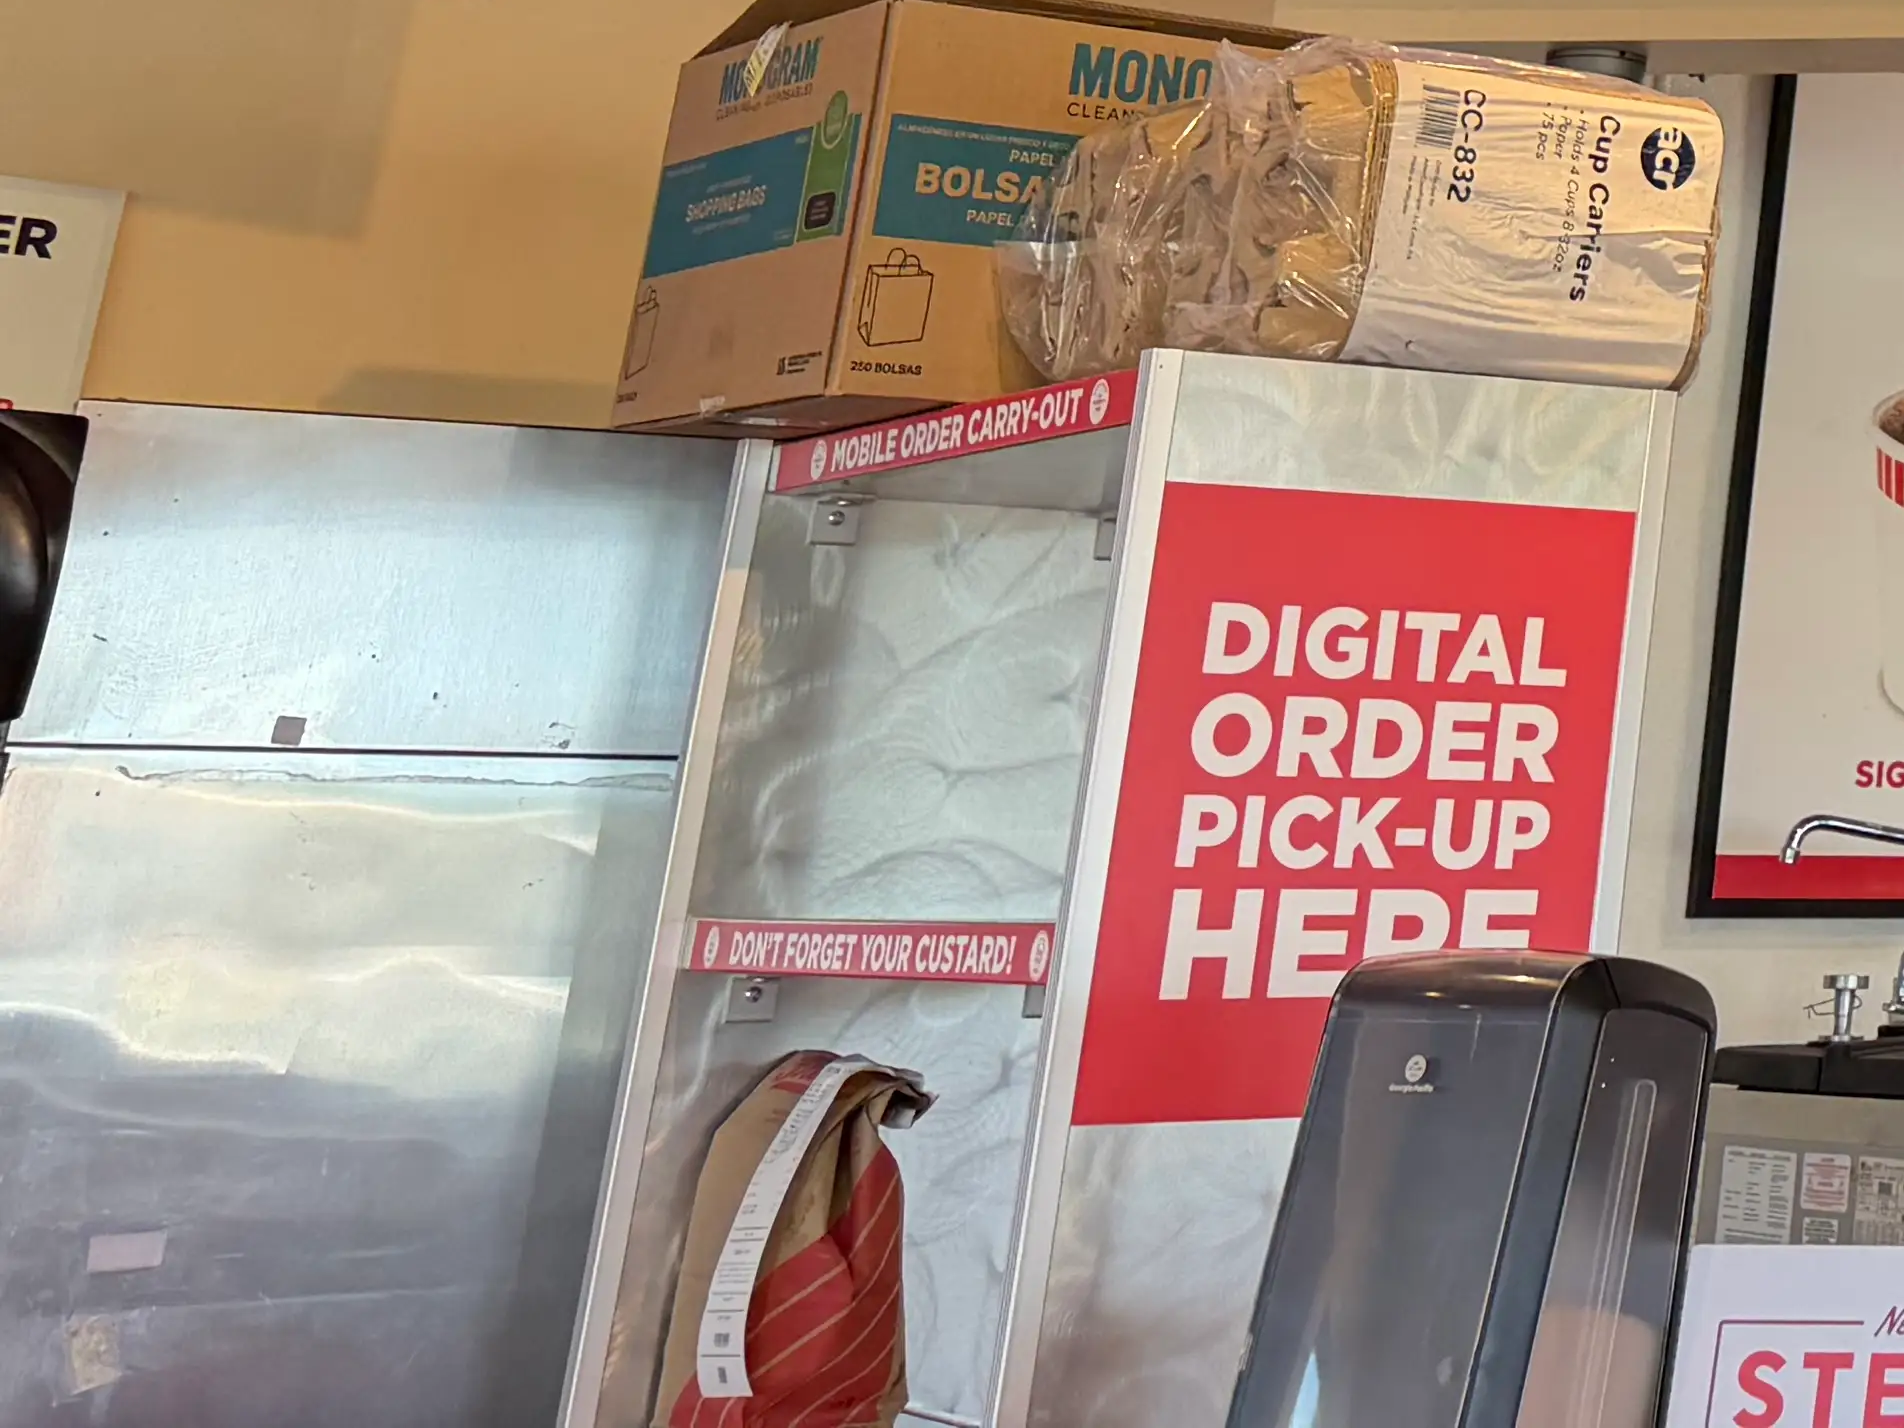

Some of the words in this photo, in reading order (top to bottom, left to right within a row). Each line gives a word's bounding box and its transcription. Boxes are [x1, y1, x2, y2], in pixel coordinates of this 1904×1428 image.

[1540, 113, 1554, 129] 75
[1554, 116, 1572, 158] Paper
[1571, 120, 1589, 161] Holds
[1446, 90, 1486, 203] CC-832
[1536, 132, 1547, 160] pcs
[1588, 116, 1620, 173] Cup
[967, 210, 1013, 226] PAPEL
[1562, 180, 1579, 216] Cups
[1566, 183, 1609, 300] Carriers
[875, 363, 922, 375] BOLSAS
[831, 429, 898, 472] MOBILE
[901, 415, 963, 457] ORDER
[968, 388, 1083, 444] CARRY-OUT
[1203, 602, 1566, 686] DIGITAL
[1191, 693, 1558, 782] ORDER
[1175, 795, 1550, 870] PICK-UP
[729, 932, 783, 967] DON'T
[784, 934, 861, 969] FORGET
[861, 935, 912, 971] YOUR
[916, 935, 1016, 974] CUSTARD!
